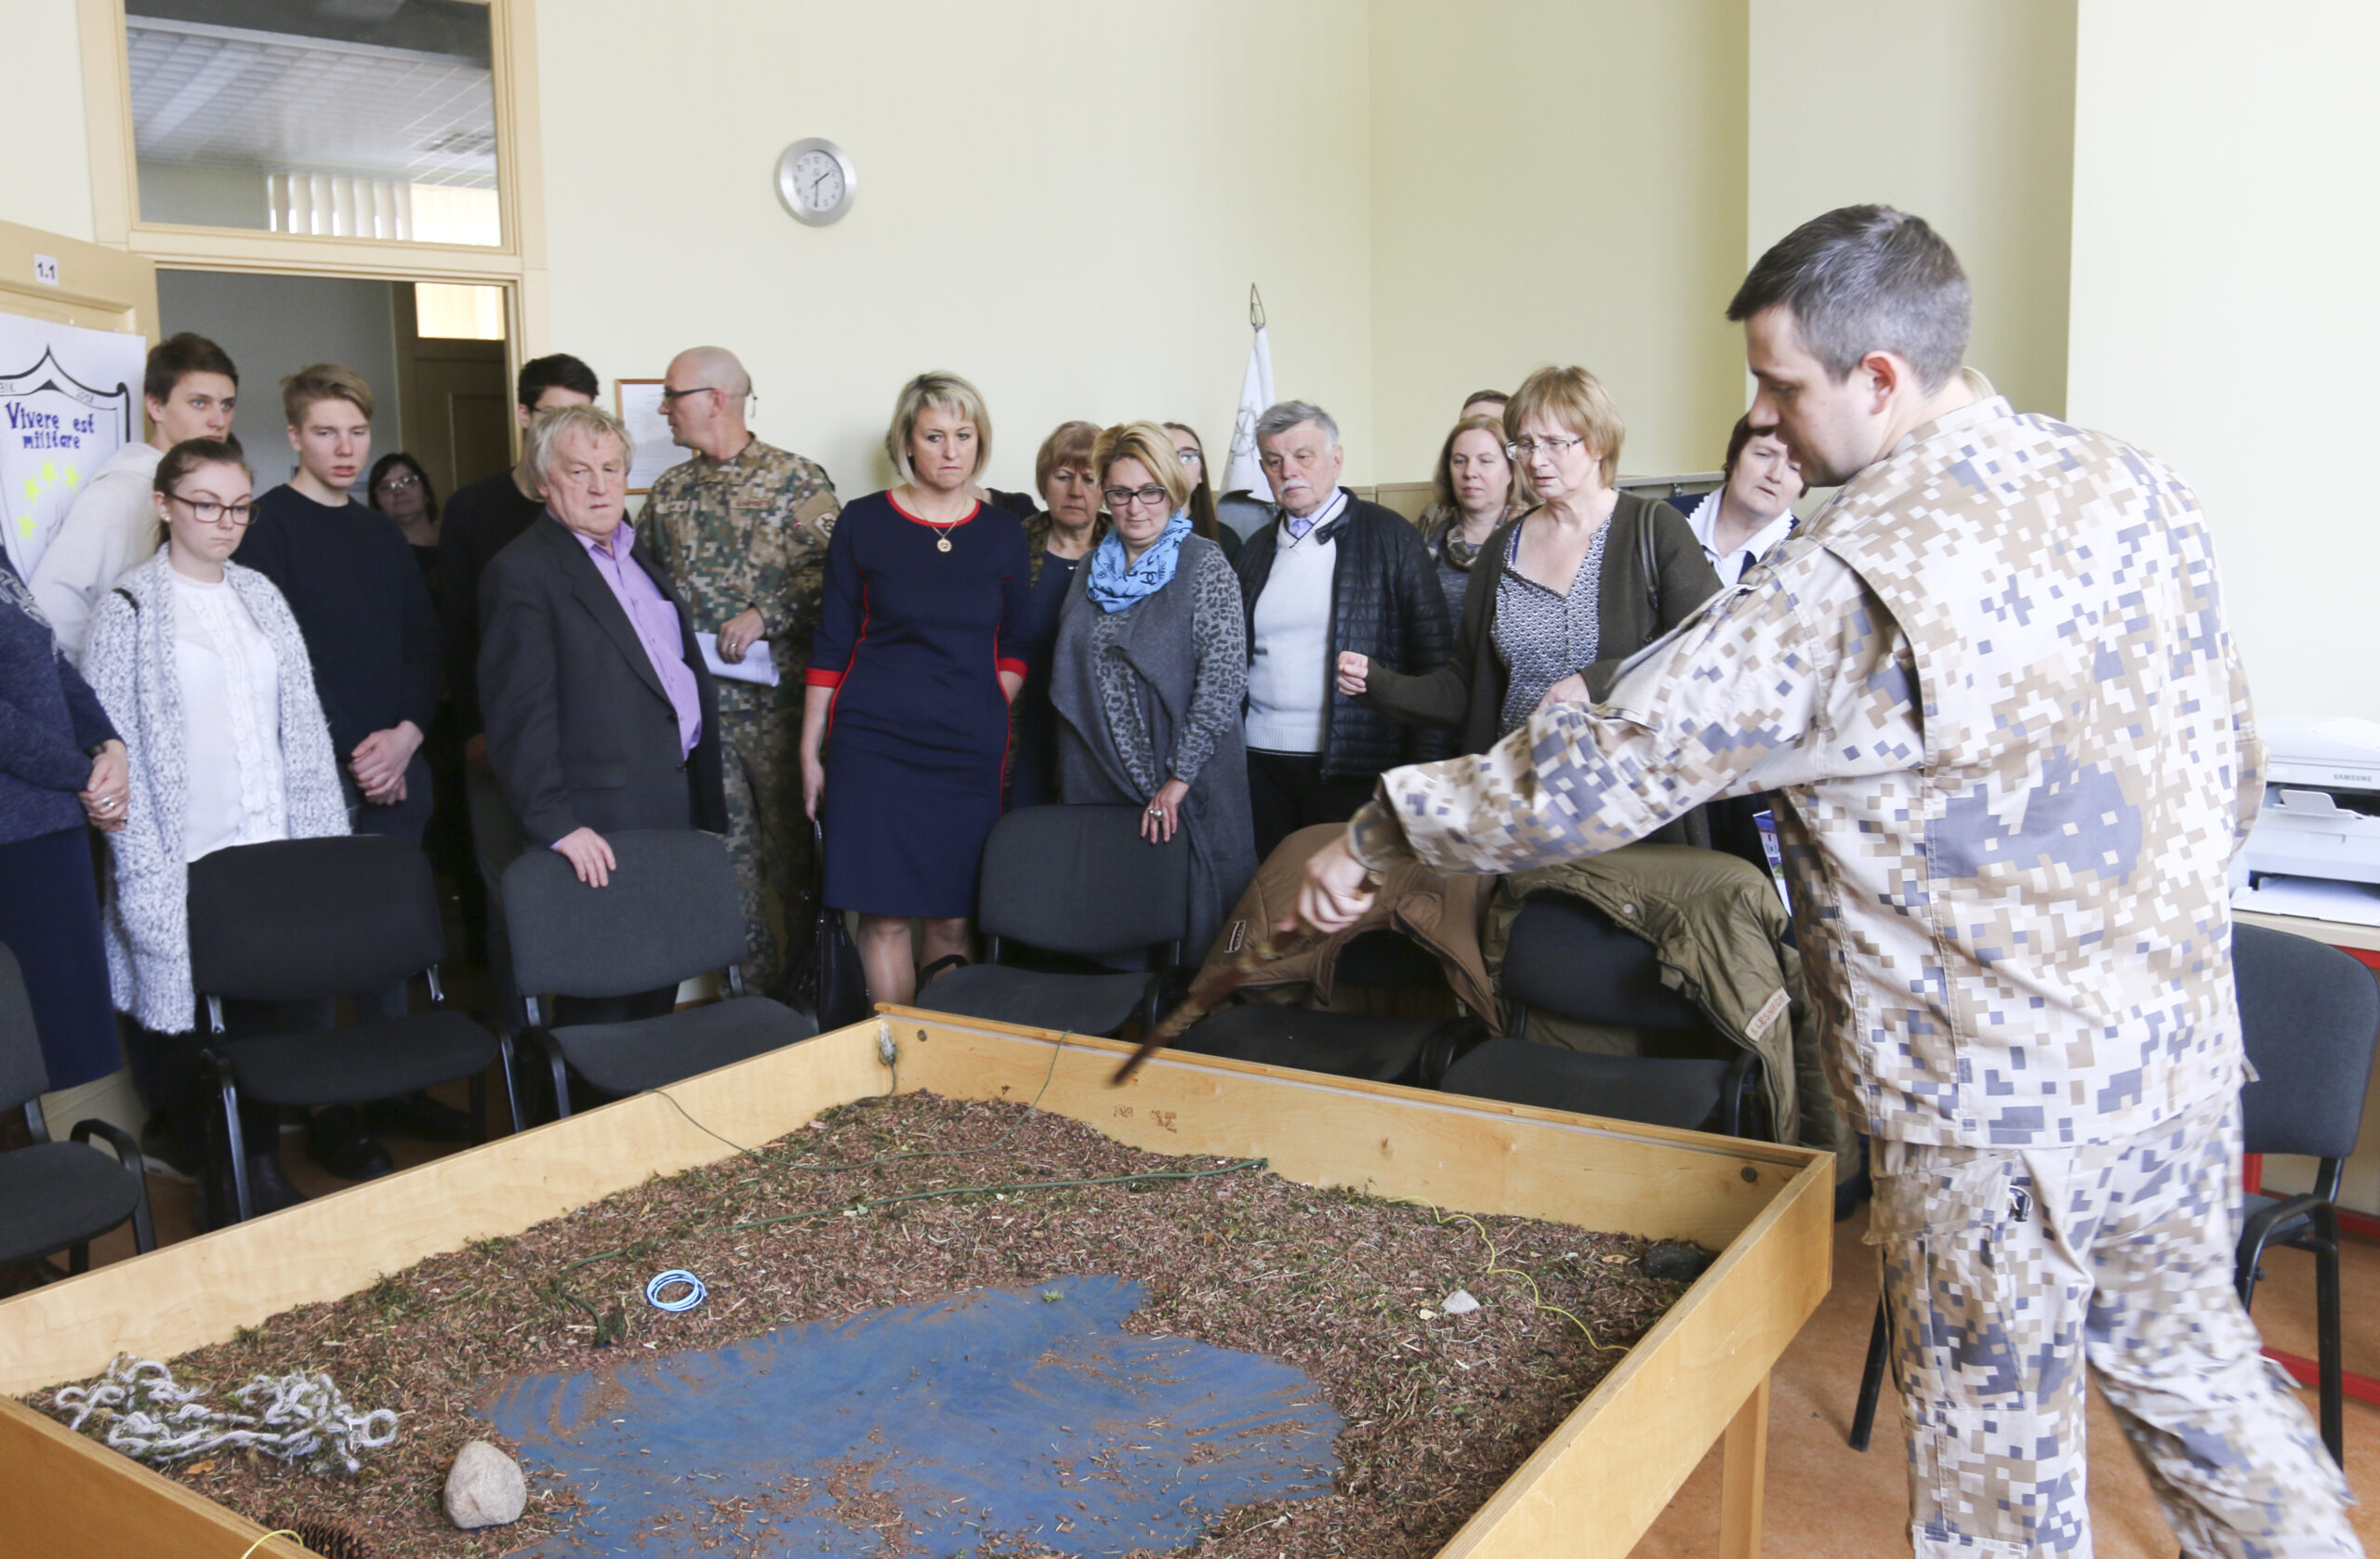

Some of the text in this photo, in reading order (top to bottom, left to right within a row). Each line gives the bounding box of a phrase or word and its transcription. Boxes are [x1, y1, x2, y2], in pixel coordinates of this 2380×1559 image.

[37, 262, 55, 280] 1.1
[5, 402, 95, 433] Vivere est
[22, 429, 80, 449] militare
[2334, 773, 2372, 782] SAMSUNG
